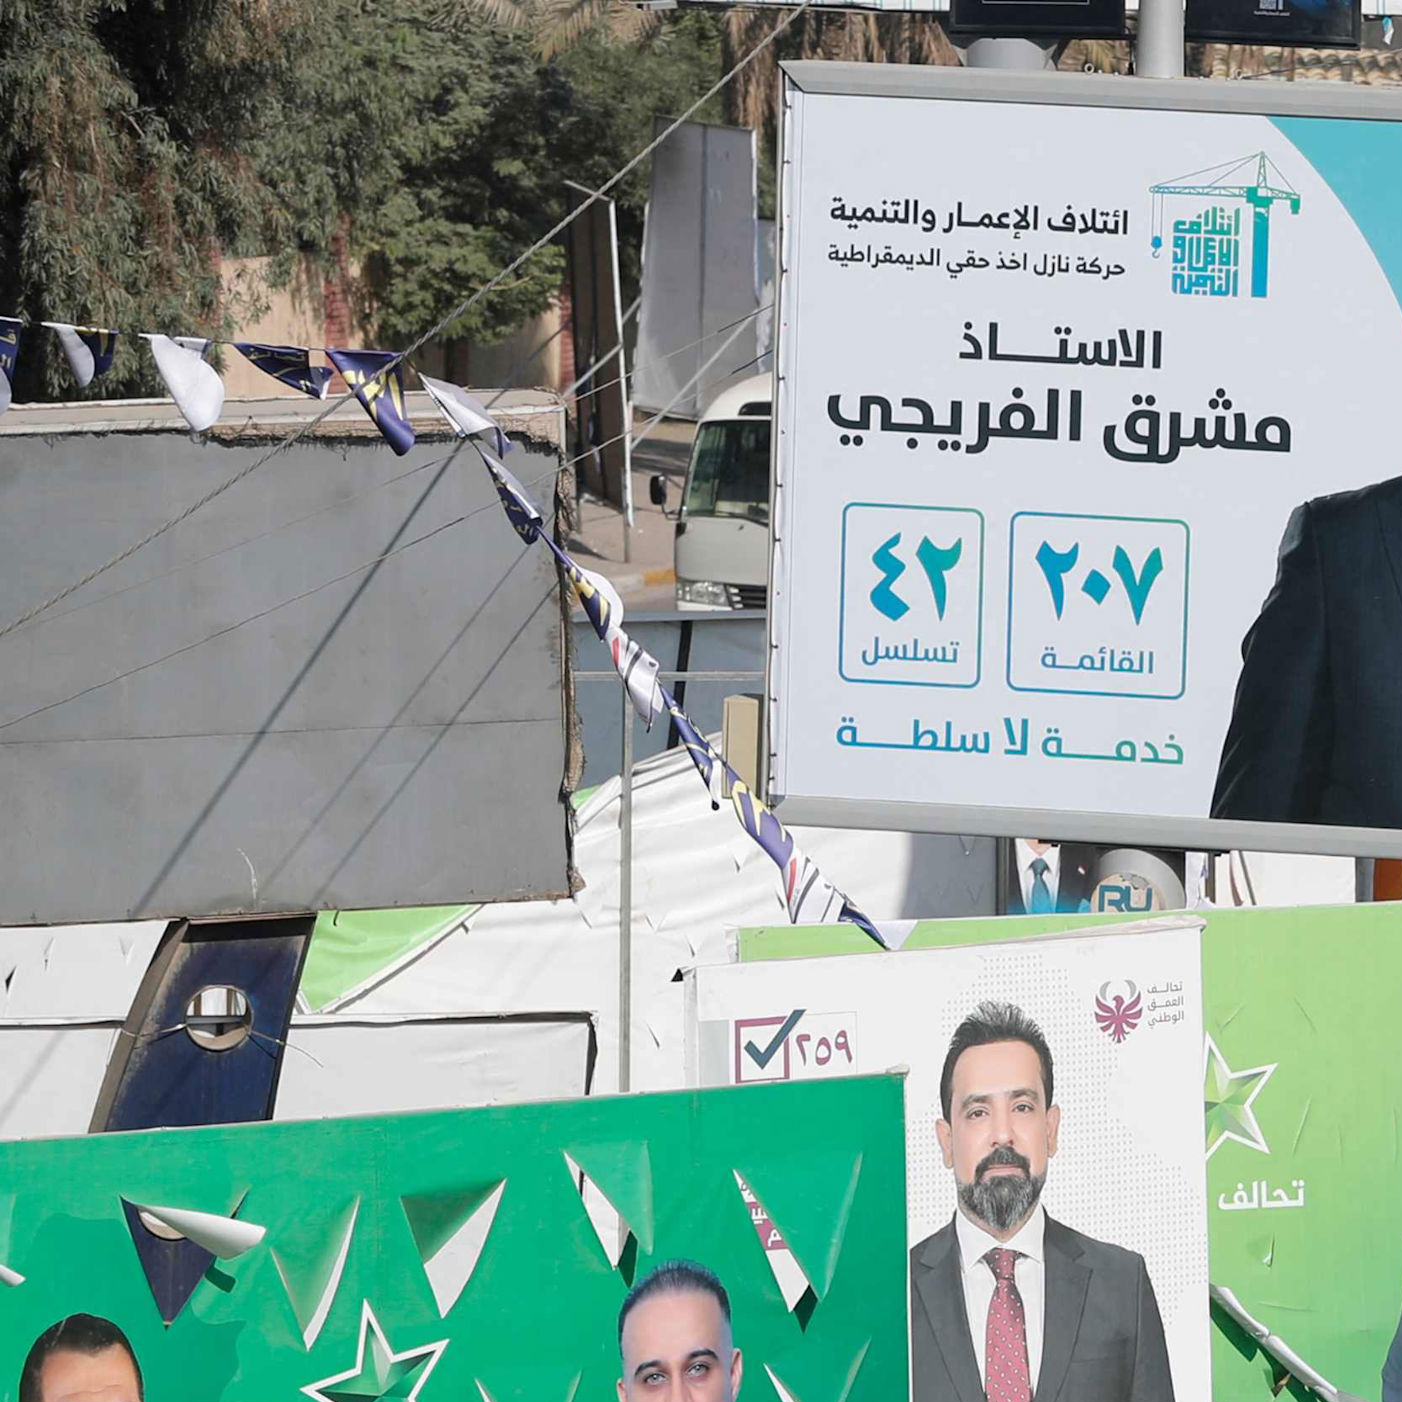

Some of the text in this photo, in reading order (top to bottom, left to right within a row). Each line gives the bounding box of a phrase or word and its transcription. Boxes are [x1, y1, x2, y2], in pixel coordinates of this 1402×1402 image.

[829, 197, 935, 232] والتنمية
[1047, 205, 1129, 236] ائتلاف
[827, 243, 1126, 279] حركة نازل اخذ حقي الديمقراطية
[827, 387, 1292, 465] مشرق الفريجي
[870, 532, 963, 622] ٤٢
[1035, 540, 1164, 625] ٢٠٧
[861, 636, 959, 666] تسلسل
[1041, 646, 1154, 673] القائمة
[836, 716, 1184, 765] خدمة لا سلطة
[795, 1029, 853, 1067] ٢٥٩
[1218, 1179, 1305, 1211] تحالف
